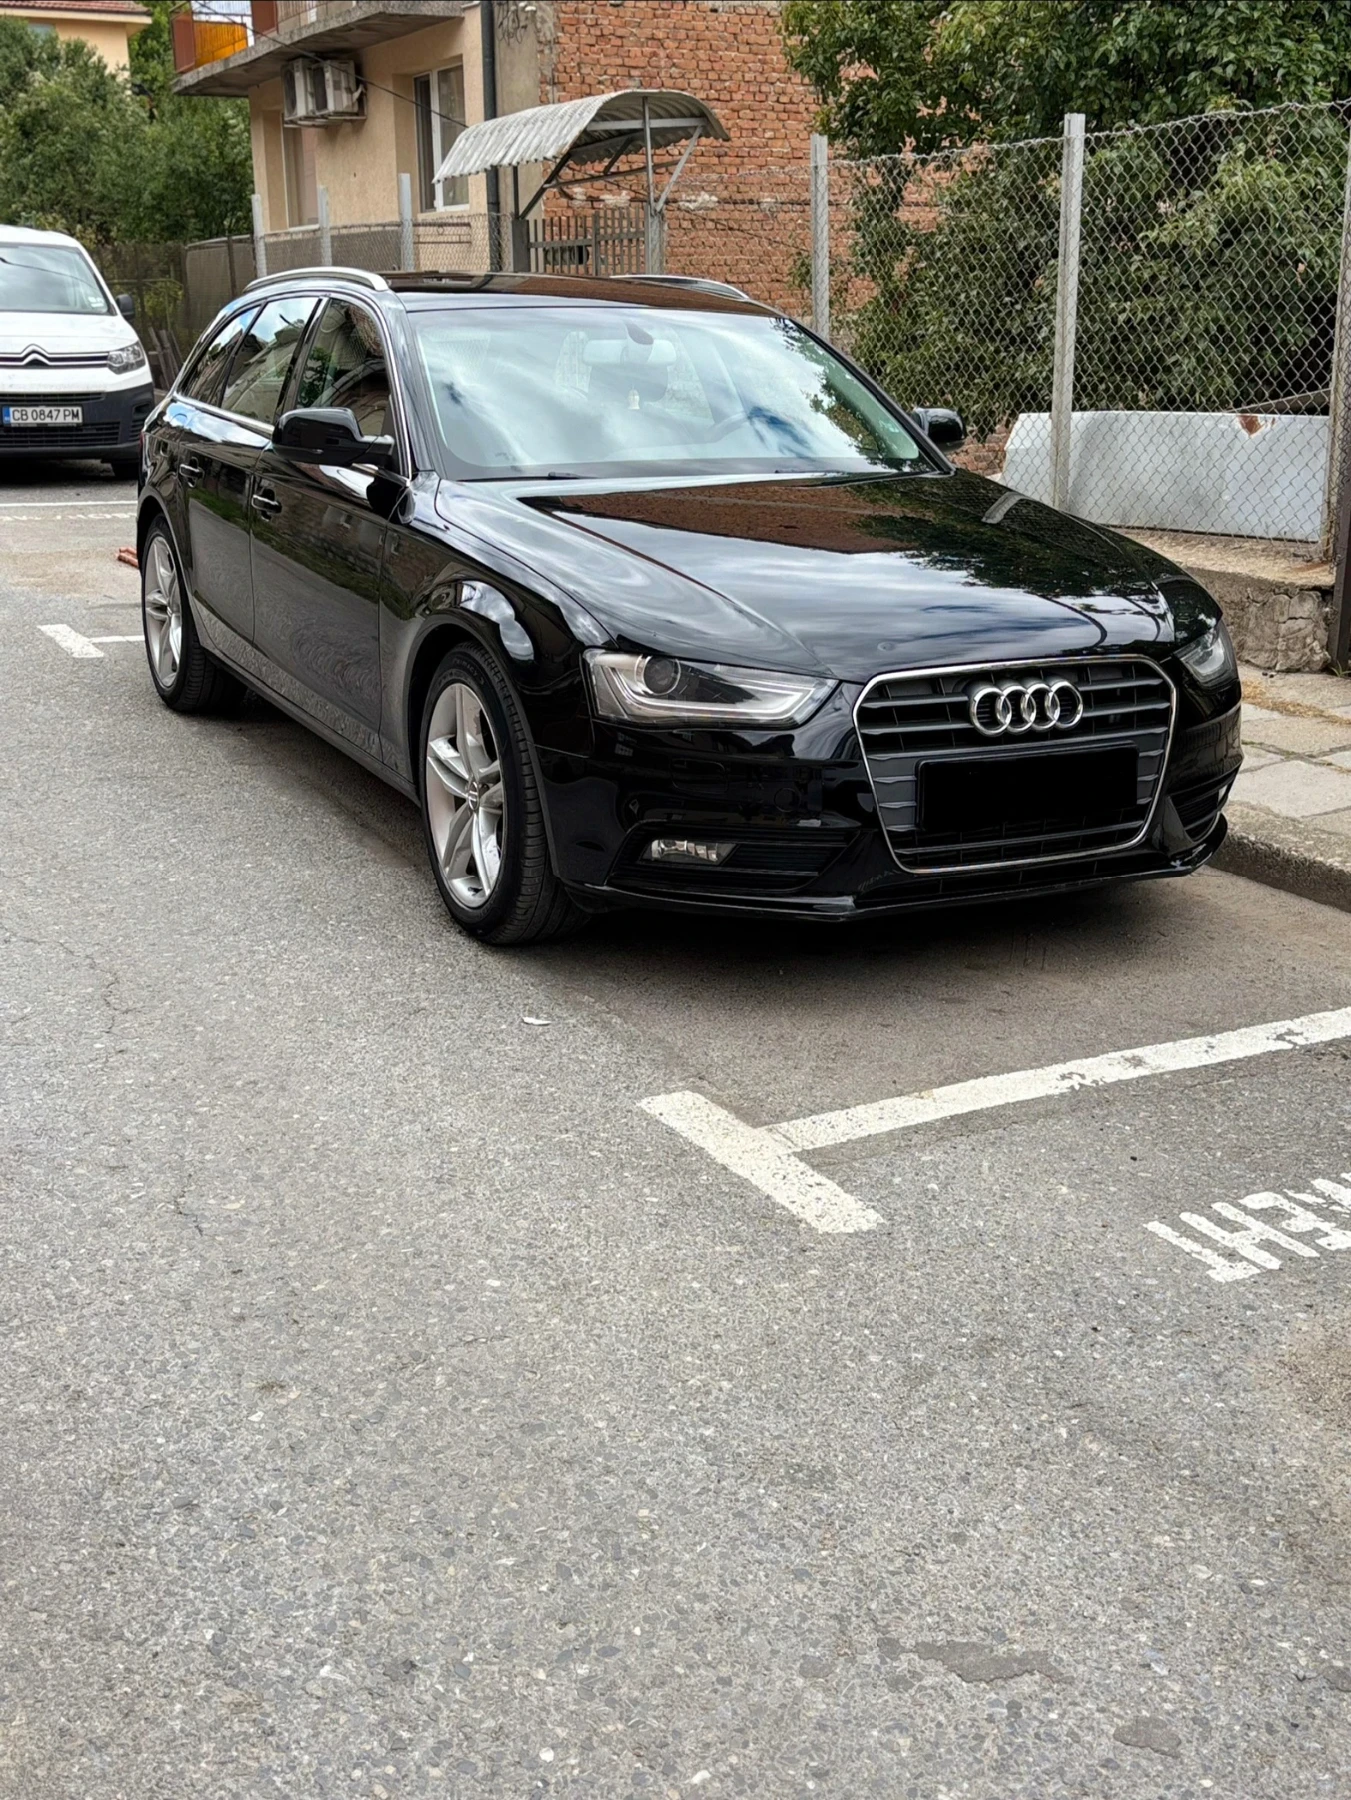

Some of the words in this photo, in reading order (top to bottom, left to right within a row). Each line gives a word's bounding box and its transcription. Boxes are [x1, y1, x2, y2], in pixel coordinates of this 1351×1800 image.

[12, 409, 29, 421] CB
[31, 409, 60, 421] 0847
[63, 409, 80, 421] PM
